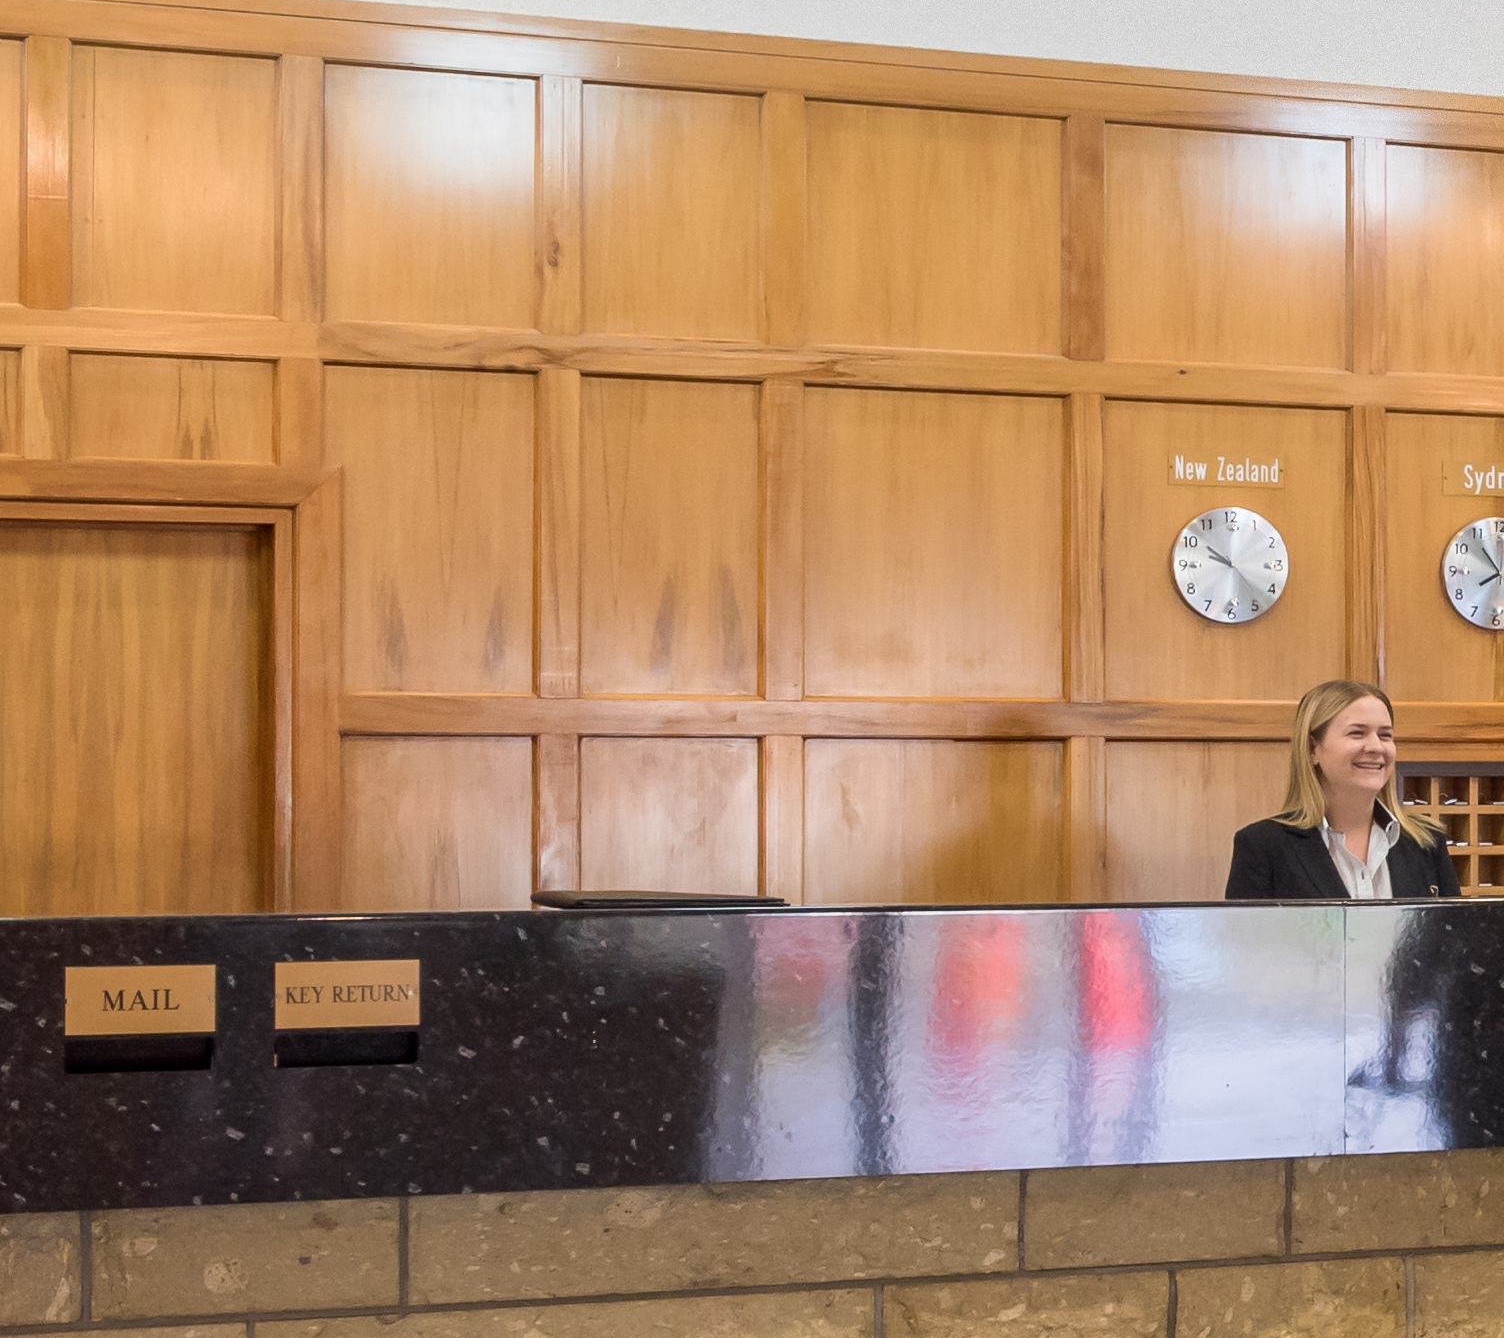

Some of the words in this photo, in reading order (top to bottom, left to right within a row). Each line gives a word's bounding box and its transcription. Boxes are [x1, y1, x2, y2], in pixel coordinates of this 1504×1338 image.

[1174, 456, 1207, 480] New
[1217, 457, 1279, 483] Zealand
[1225, 512, 1237, 523] 12
[1201, 520, 1212, 530] 11
[1473, 528, 1482, 539] 11
[1184, 536, 1197, 547] 10
[1269, 537, 1275, 548] 2
[1455, 543, 1468, 554] 10
[1179, 560, 1187, 571] 9
[1449, 566, 1457, 577] 9
[1187, 583, 1196, 594] 8
[1268, 583, 1276, 594] 4
[1455, 589, 1463, 600] 8
[1204, 600, 1212, 611] 7
[1252, 600, 1259, 611] 5
[1228, 608, 1236, 620] 6
[1471, 606, 1478, 617] 7
[1492, 614, 1500, 626] 6
[102, 988, 180, 1011] MAIL
[285, 986, 324, 1004] KEY
[332, 984, 410, 1003] RETURN
